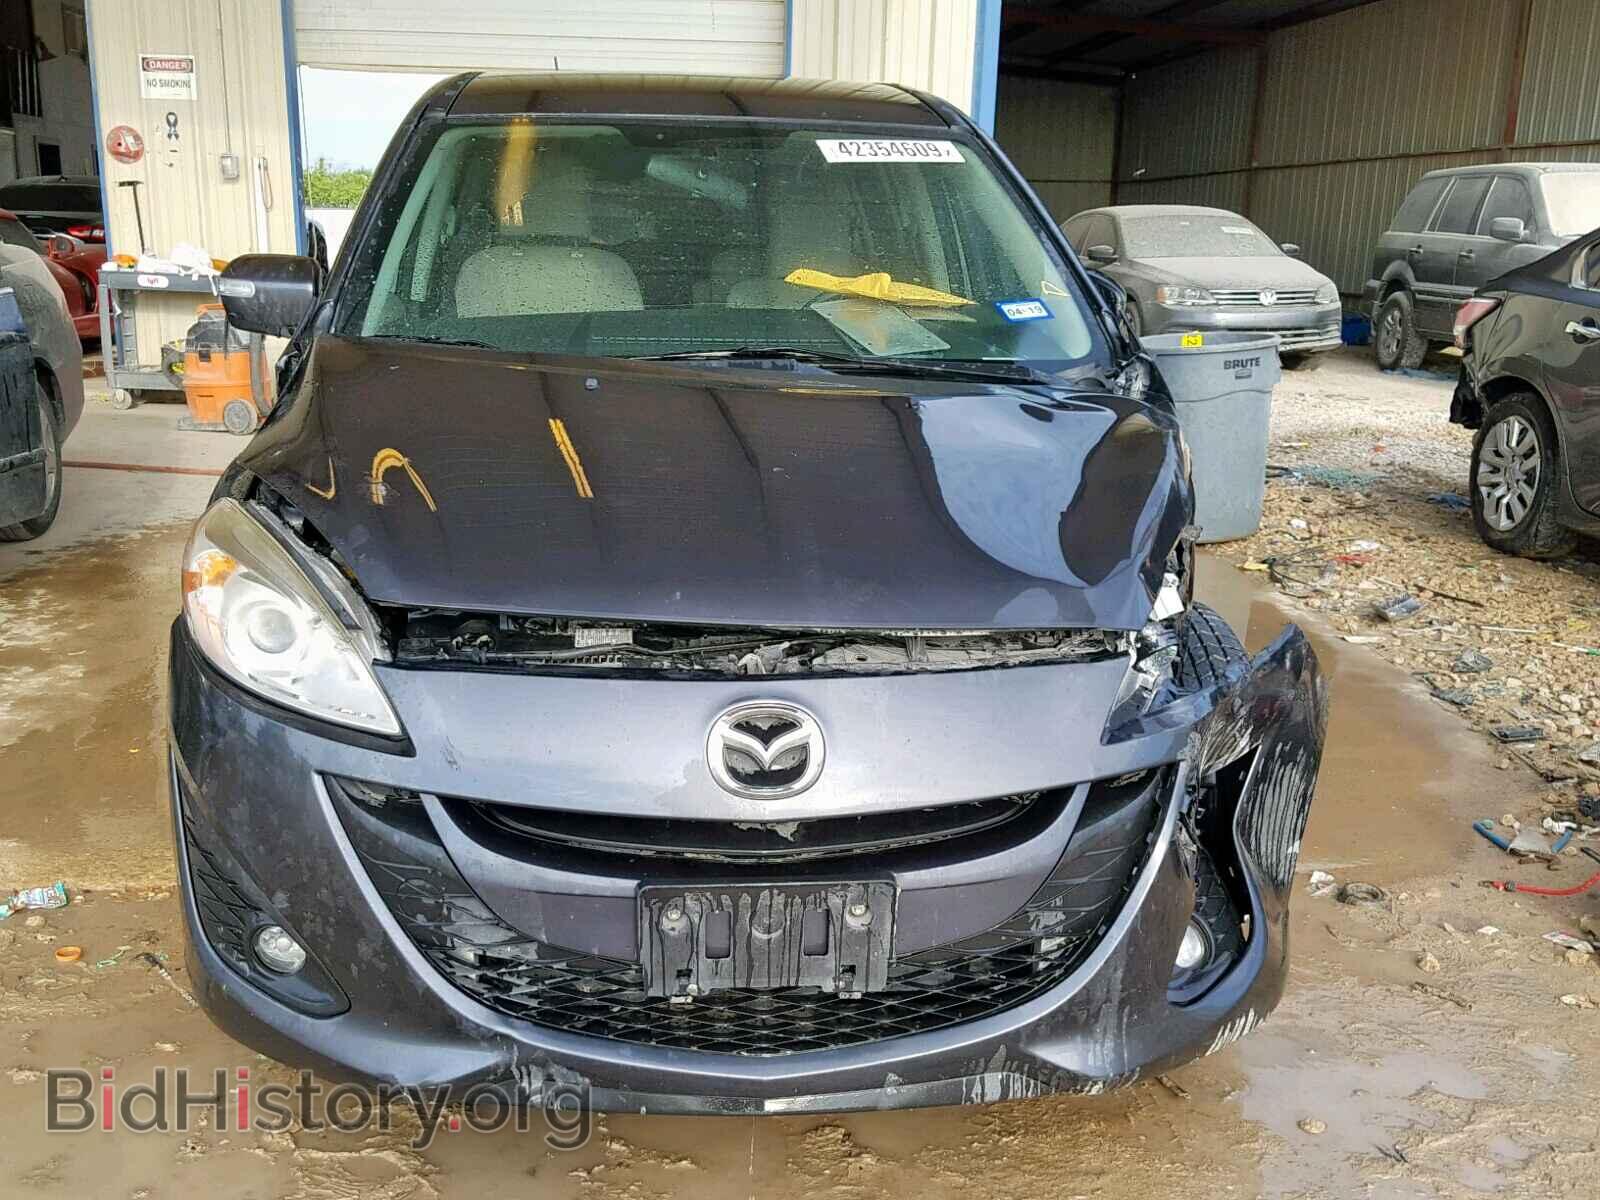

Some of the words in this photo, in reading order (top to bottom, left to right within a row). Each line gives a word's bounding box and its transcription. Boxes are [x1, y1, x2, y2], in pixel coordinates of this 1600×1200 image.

[149, 60, 188, 70] DANGER
[146, 79, 158, 89] NO
[838, 141, 943, 158] 42354609
[1223, 357, 1261, 370] BRUTE
